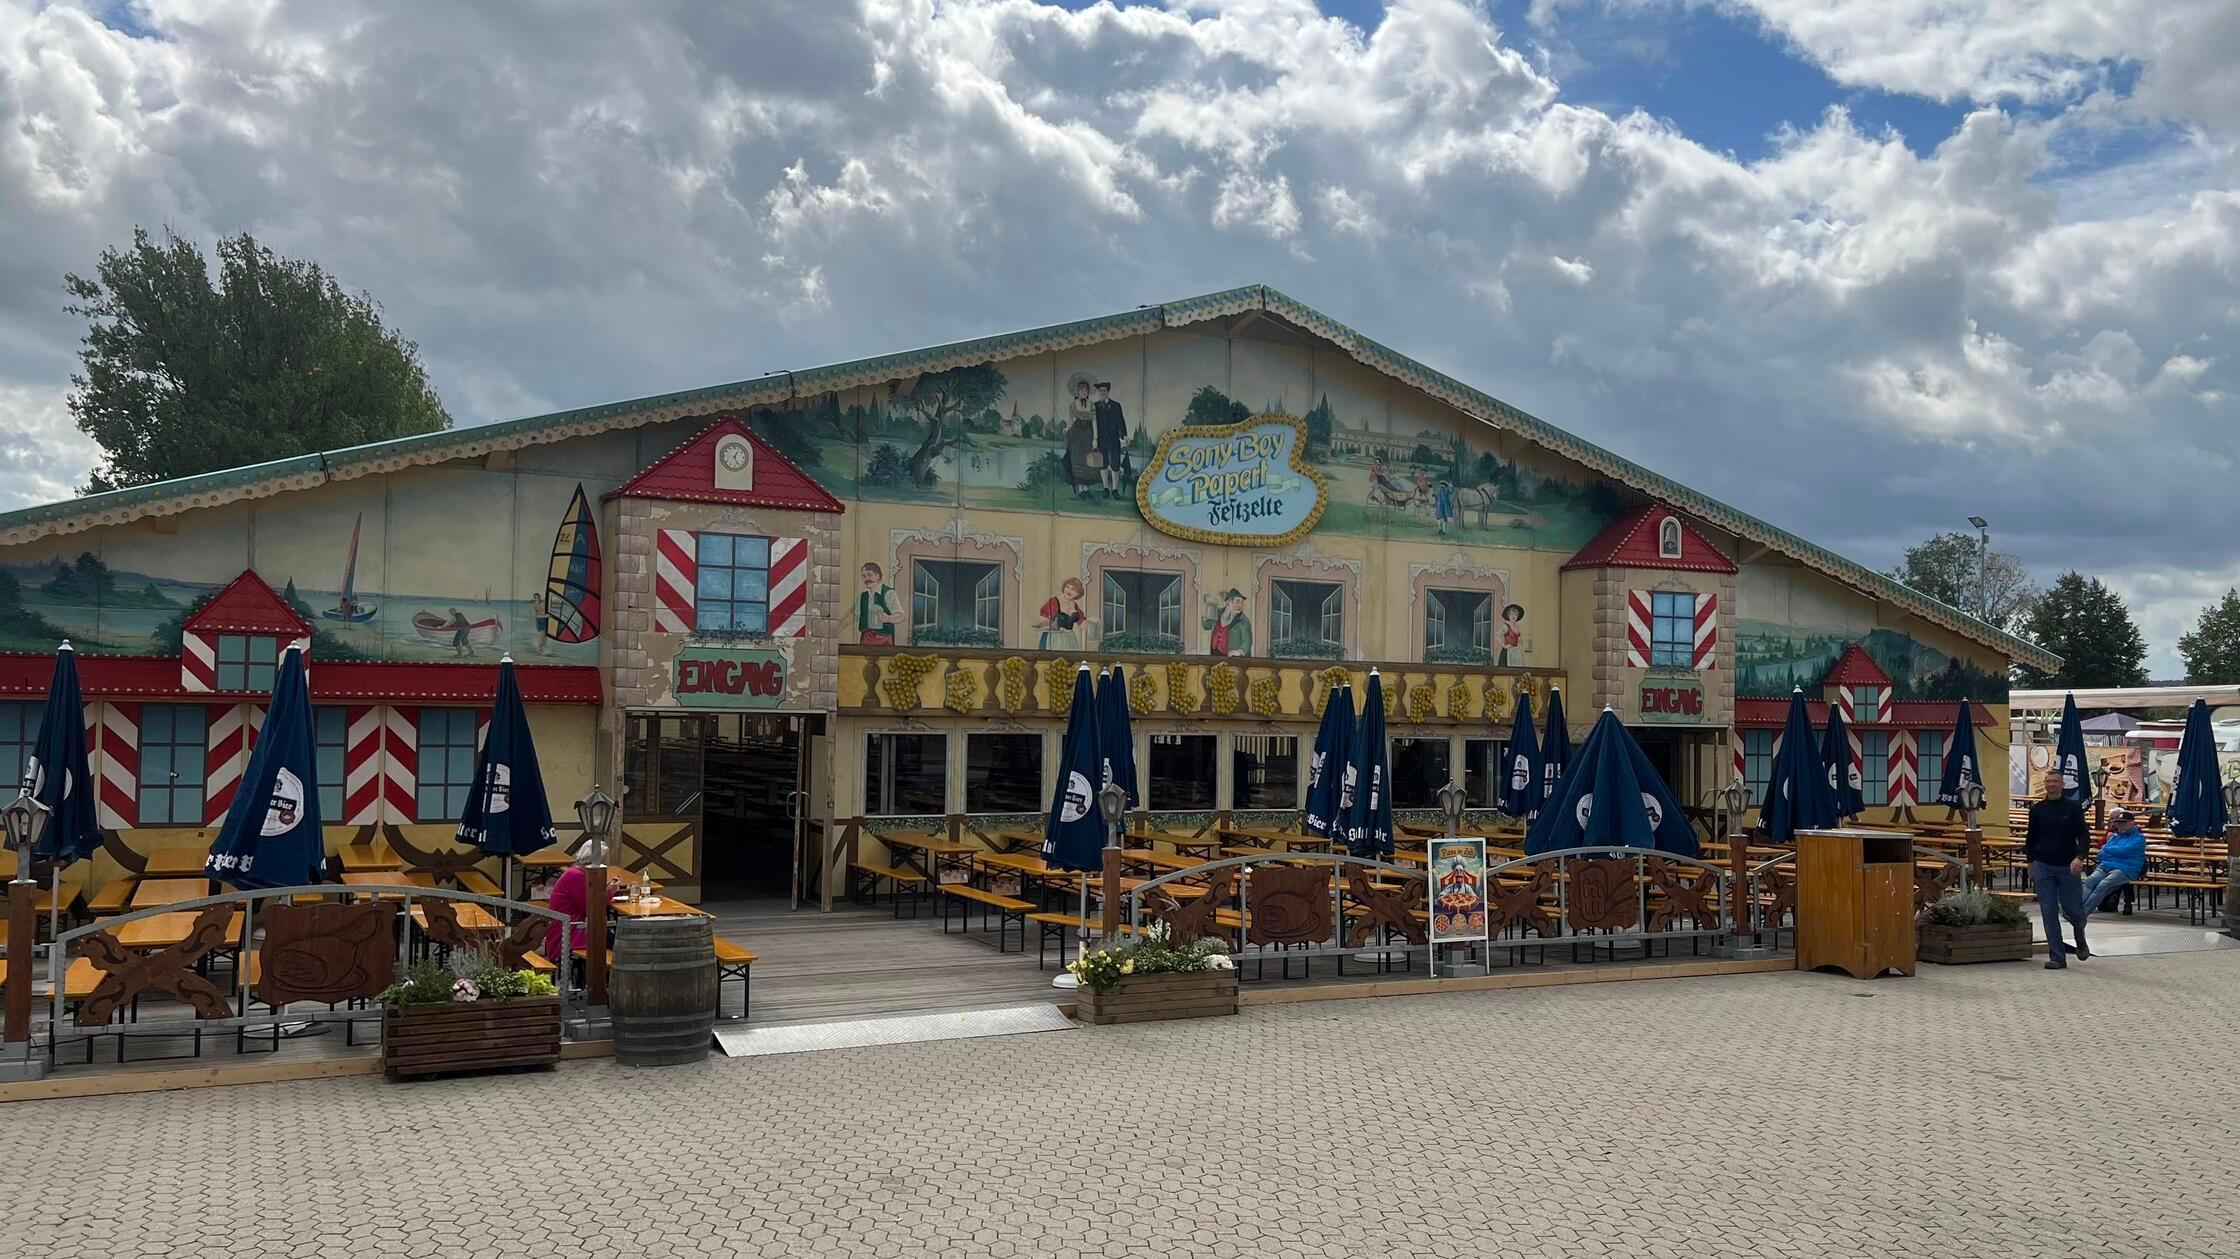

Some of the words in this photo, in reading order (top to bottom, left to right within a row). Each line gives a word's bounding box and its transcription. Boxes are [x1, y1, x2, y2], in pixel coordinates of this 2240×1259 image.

[1187, 459, 1270, 504] Papert
[1207, 496, 1285, 526] Festzelte
[676, 658, 784, 697] EINGANG
[882, 652, 1279, 718] Festelte
[1641, 686, 1703, 715] EINGANG
[1307, 813, 1327, 830] Bier
